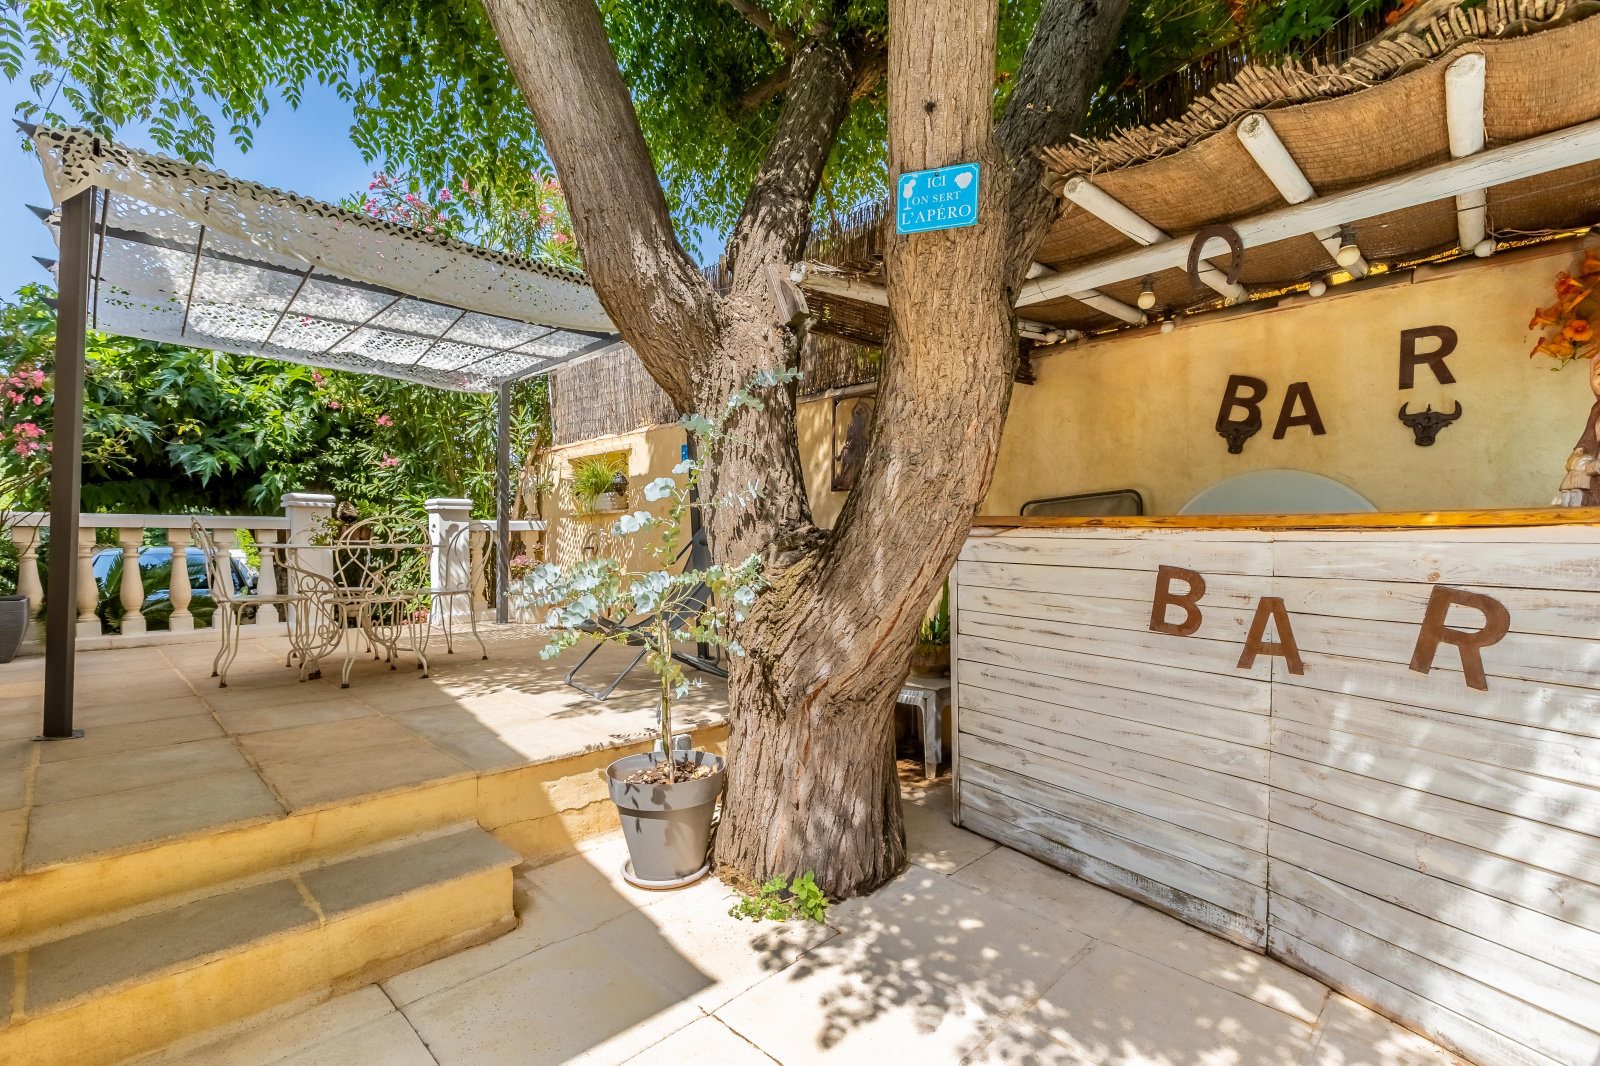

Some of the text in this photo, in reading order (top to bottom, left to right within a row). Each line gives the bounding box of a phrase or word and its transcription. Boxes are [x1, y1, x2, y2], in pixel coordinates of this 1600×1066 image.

[927, 175, 946, 188] ICI
[912, 191, 961, 205] ON SERT
[901, 204, 971, 225] L'APÉRO
[1150, 564, 1510, 691] BAR
